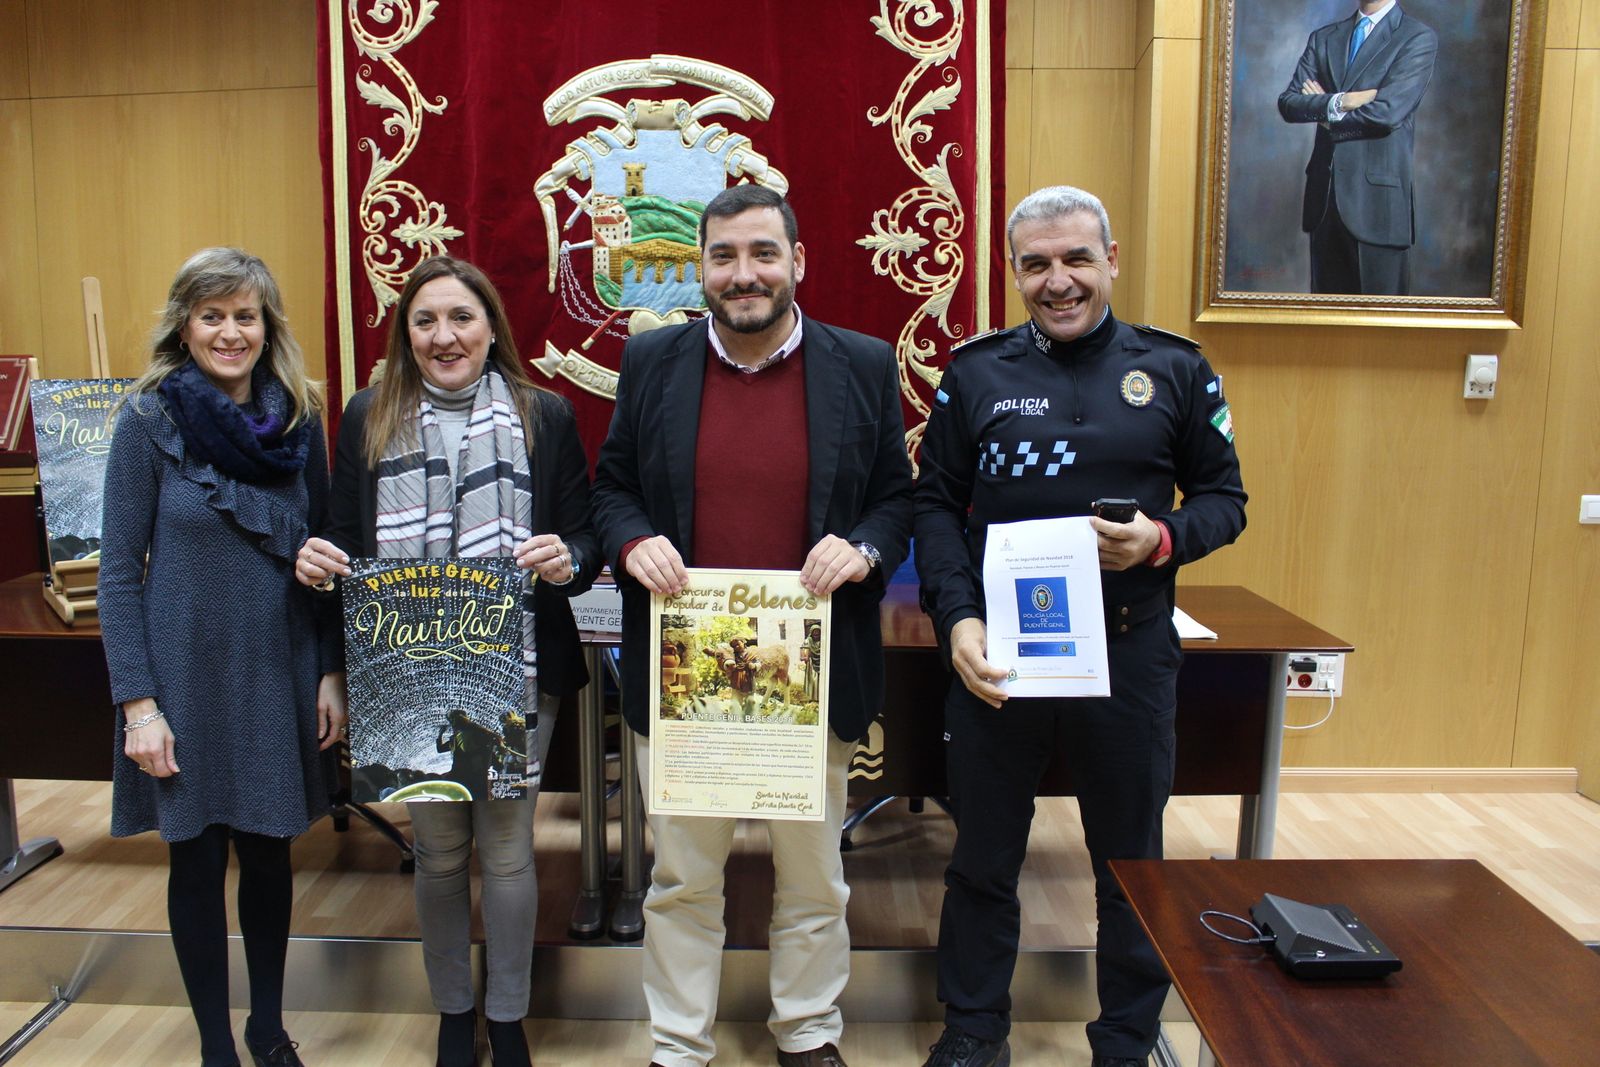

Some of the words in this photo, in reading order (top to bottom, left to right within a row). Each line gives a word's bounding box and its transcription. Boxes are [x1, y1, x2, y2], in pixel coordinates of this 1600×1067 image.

[576, 73, 614, 94] NATURA
[51, 384, 109, 405] PUENTE
[87, 399, 110, 408] luz
[993, 398, 1049, 414] POLICIA
[1021, 407, 1045, 416] LOCAL
[366, 565, 440, 592] PUENTE
[445, 562, 502, 590] GENIL
[396, 589, 406, 597] la
[411, 584, 440, 598] luz
[445, 589, 458, 597] de
[460, 589, 470, 597] la
[728, 583, 818, 614] Belenes
[664, 597, 709, 614] Popular
[356, 594, 514, 660] Navidad
[477, 643, 511, 652] 2018
[681, 712, 713, 720] PUENTE
[745, 714, 771, 723] BASES
